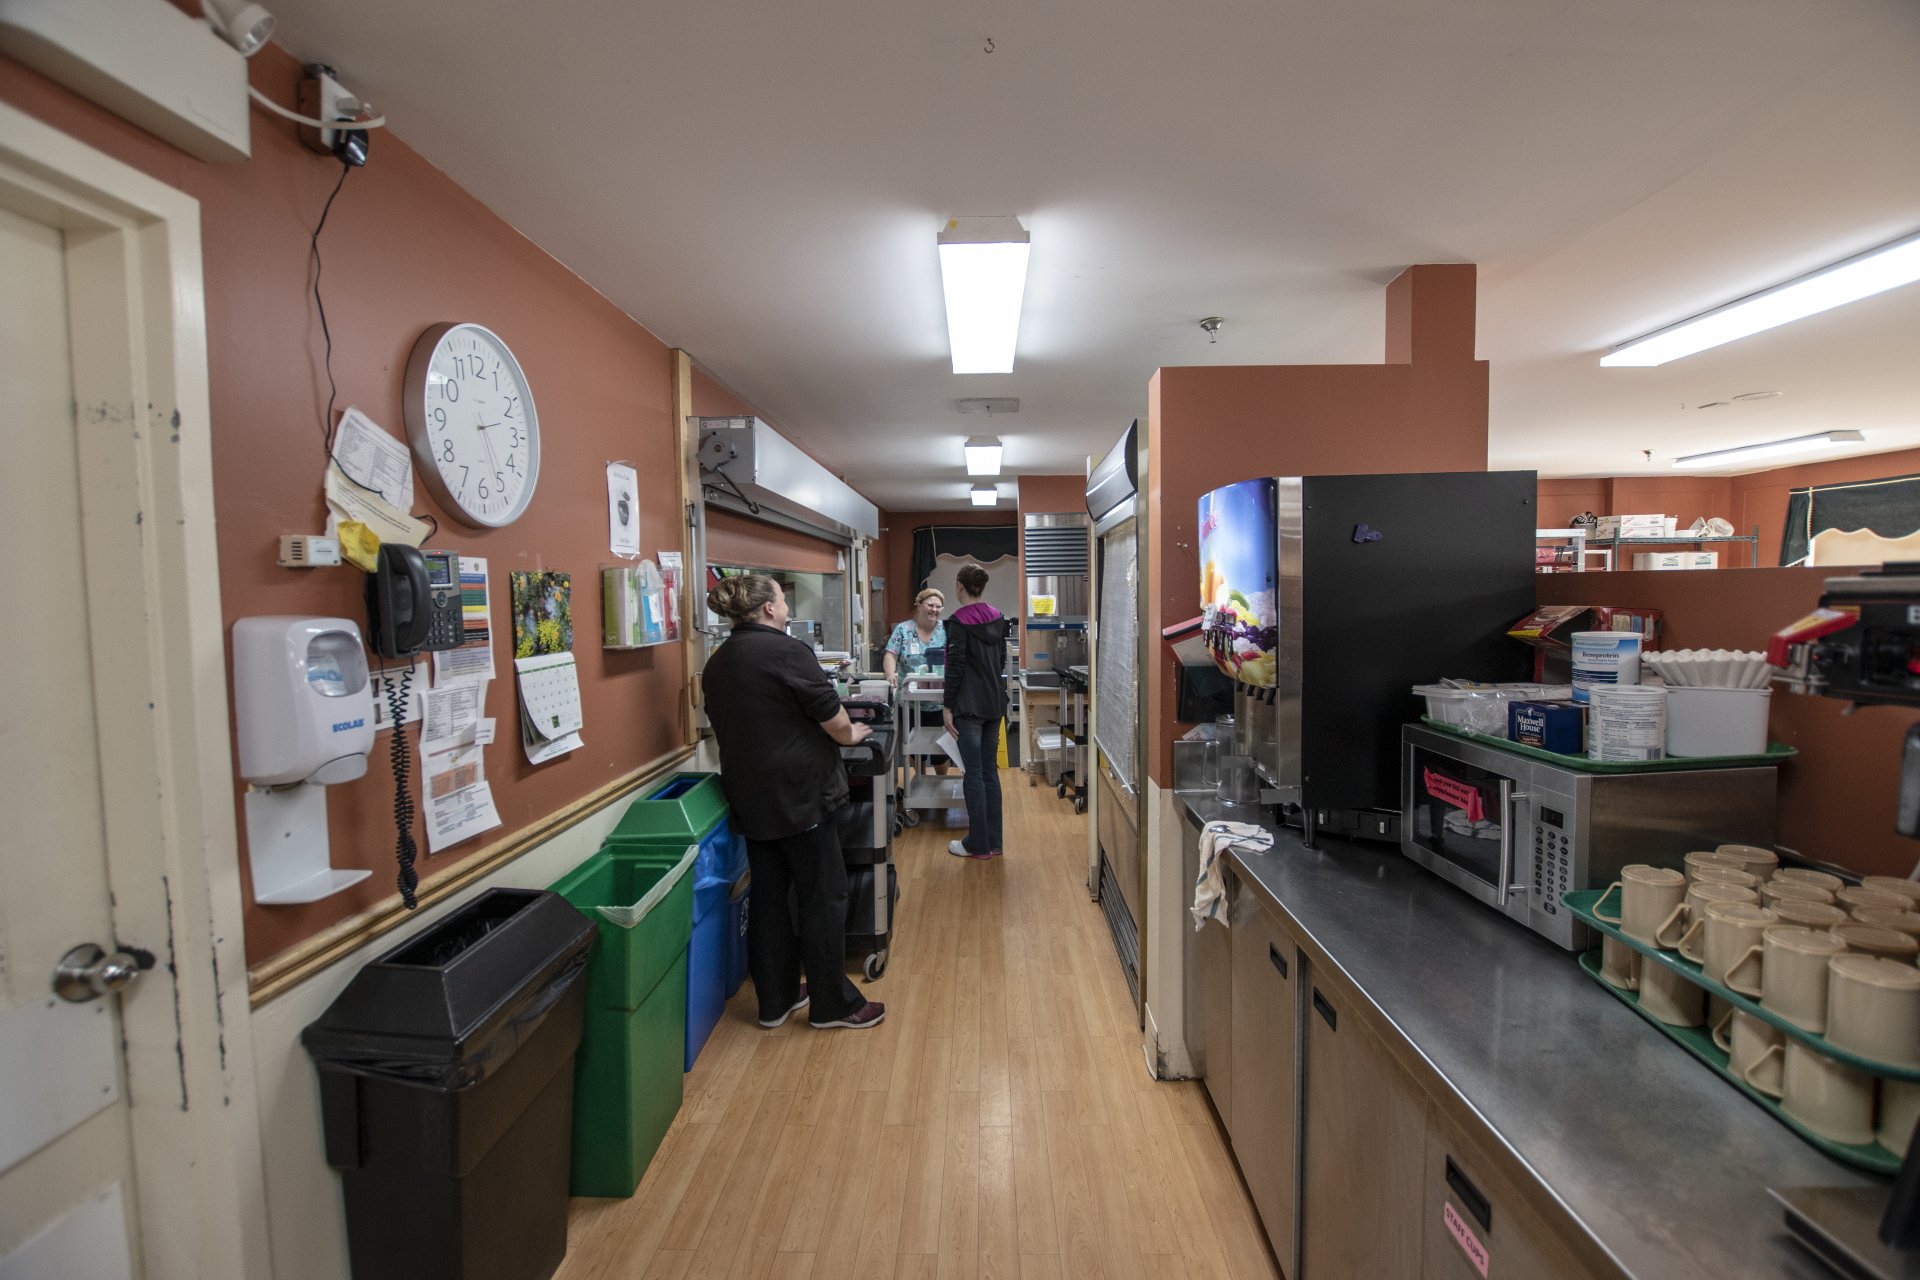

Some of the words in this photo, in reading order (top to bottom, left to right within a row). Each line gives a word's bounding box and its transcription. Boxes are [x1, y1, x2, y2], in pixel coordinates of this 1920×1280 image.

[452, 356, 465, 381] 11
[467, 353, 486, 380] 12
[439, 375, 459, 403] 10
[492, 370, 499, 392] 1
[433, 407, 447, 431] 9
[503, 396, 514, 419] 2
[509, 427, 519, 449] 3
[443, 439, 455, 463] 8
[505, 453, 516, 473] 4
[459, 465, 469, 488] 7
[496, 471, 505, 493] 5
[478, 477, 489, 500] 6
[1582, 651, 1619, 660] Beneprotein
[332, 718, 365, 733] ECOLAB
[1517, 714, 1544, 727] Maxwell
[1520, 722, 1541, 733] House
[1446, 1207, 1465, 1239] STAFF
[1465, 1235, 1485, 1266] CUPS
